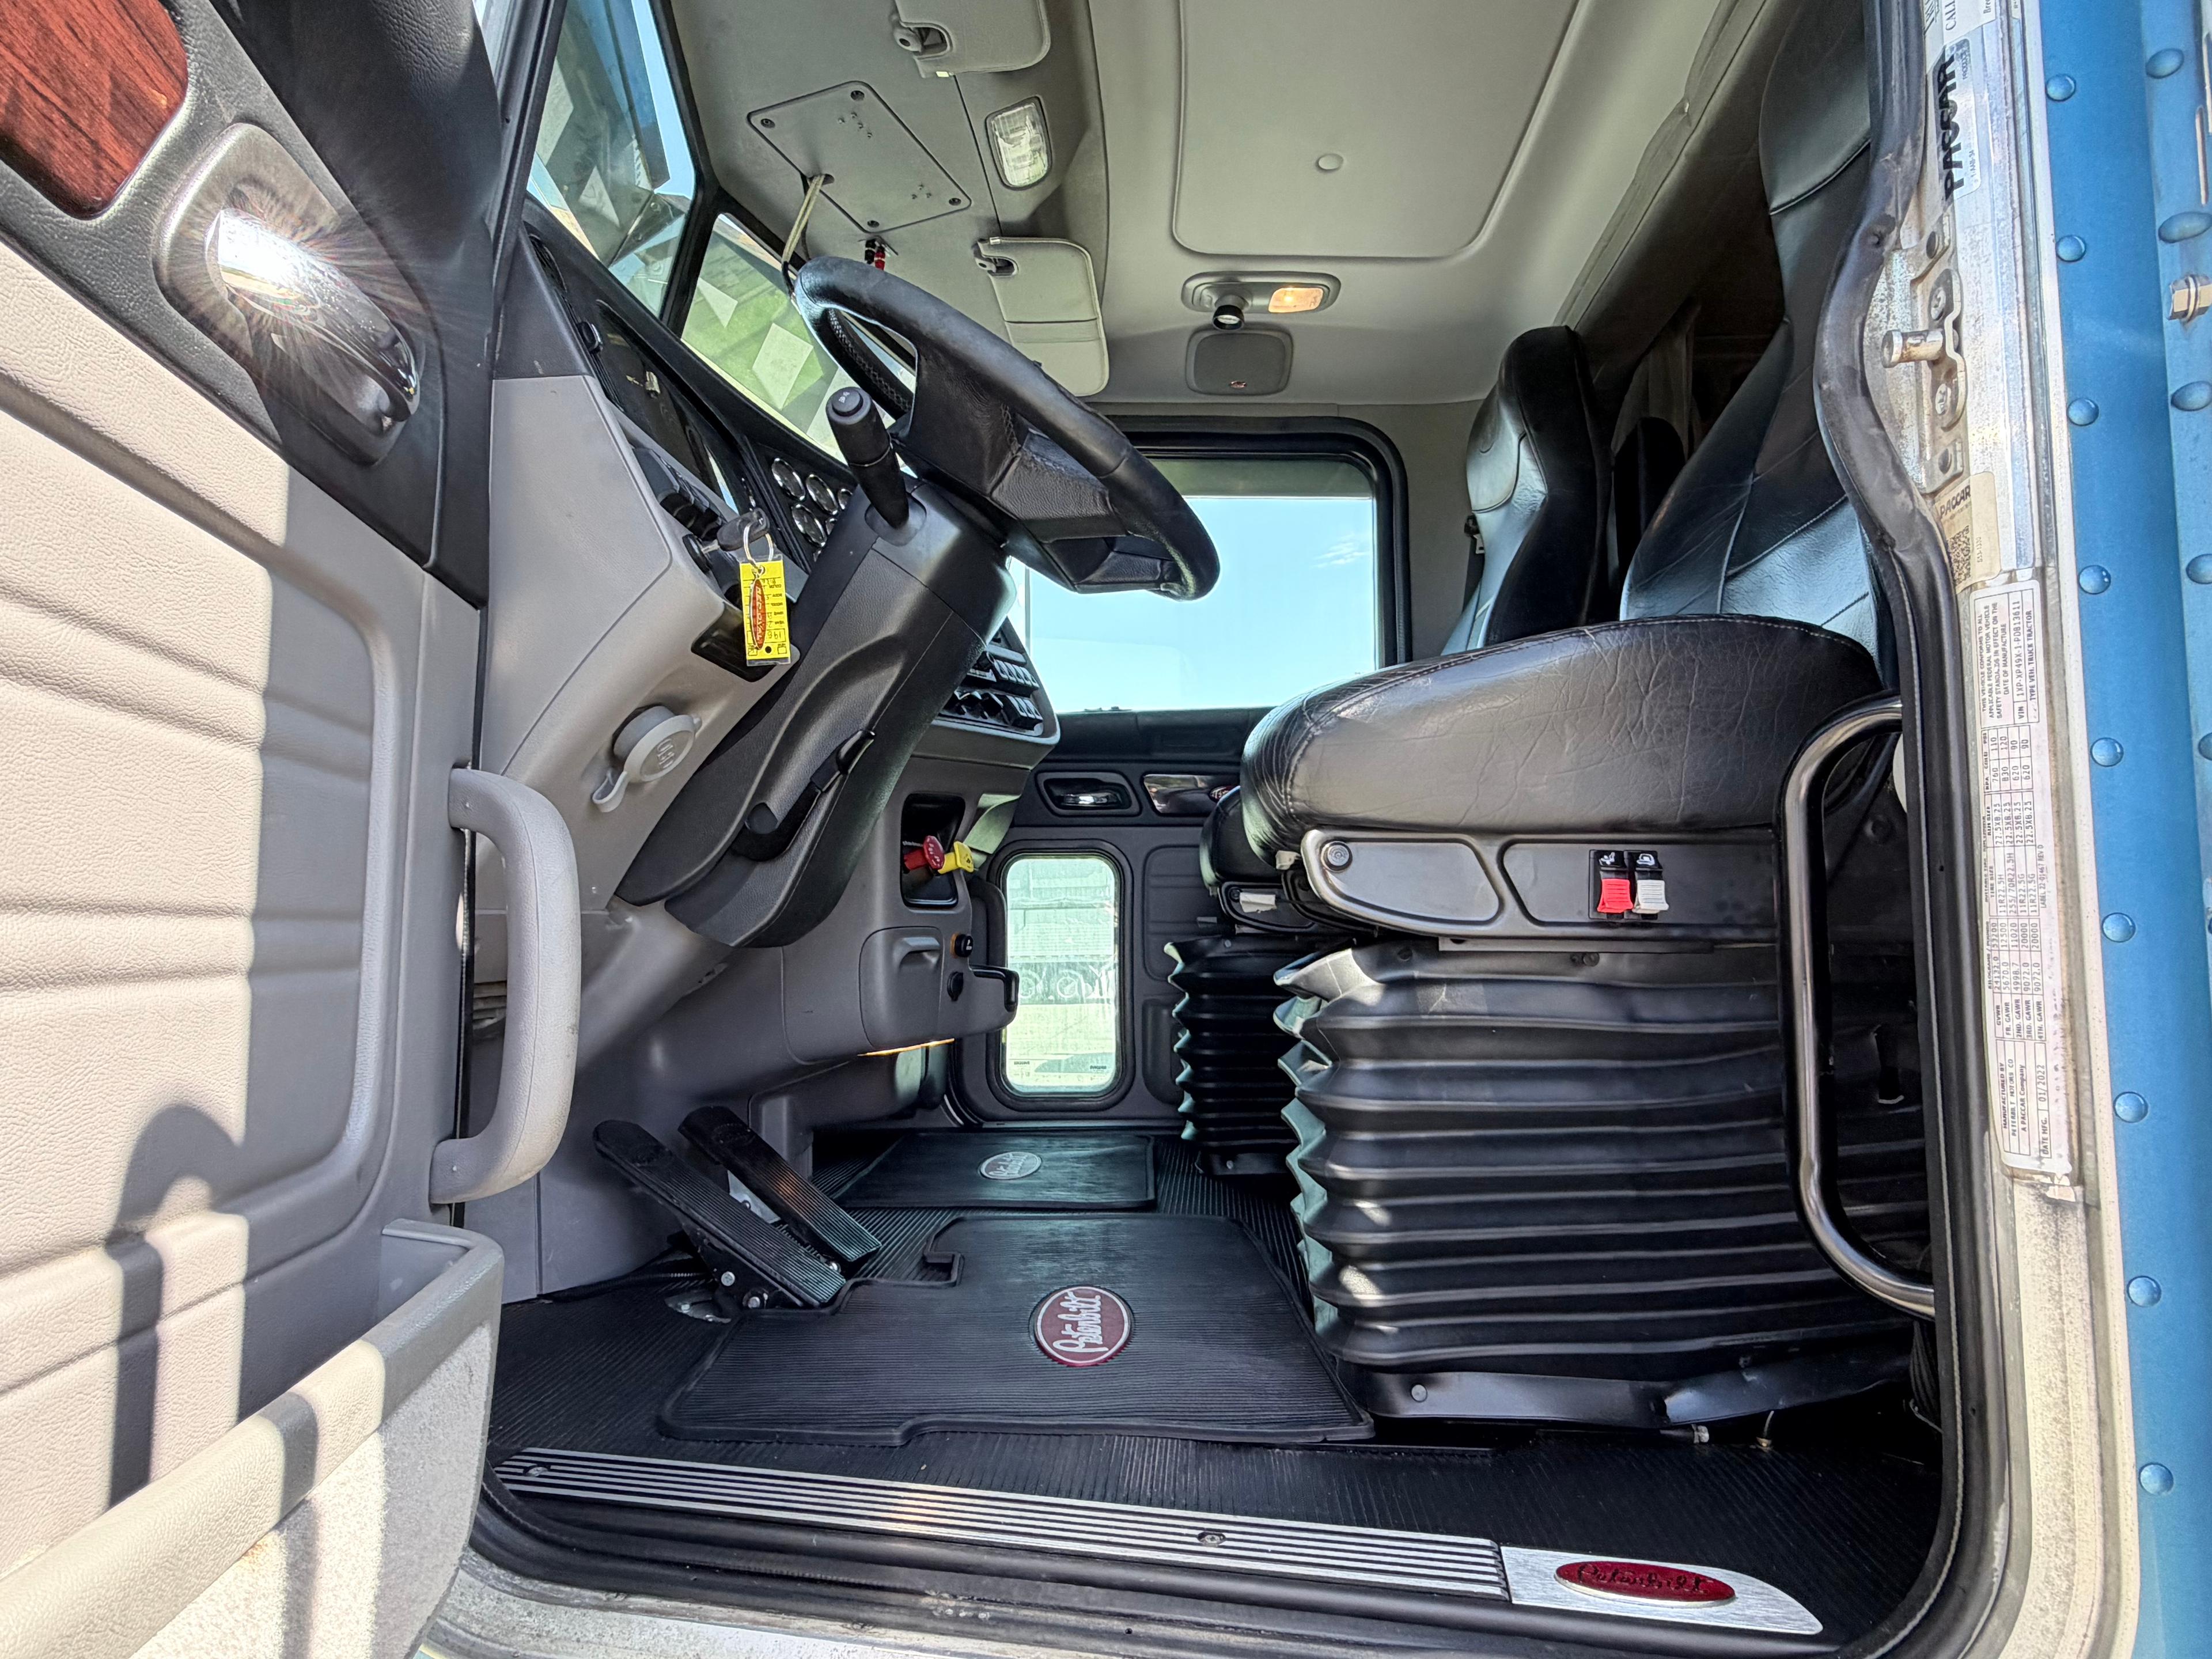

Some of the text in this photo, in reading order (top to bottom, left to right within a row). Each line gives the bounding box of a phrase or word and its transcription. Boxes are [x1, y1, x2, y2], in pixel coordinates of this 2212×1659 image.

[1937, 54, 1964, 199] PACCAR
[1941, 485, 1971, 516] PACCAR
[1978, 626, 1983, 635] TO
[1992, 616, 1998, 624] ON
[2000, 736, 2009, 781] 830 120
[2012, 766, 2020, 781] 620
[2021, 739, 2030, 779] 620 90
[1998, 874, 2006, 913] 11R22.5H
[2006, 853, 2017, 914] 255/70R22.5H
[2018, 873, 2027, 913] 11R22.5G
[2028, 873, 2037, 913] 11R22.5G
[2031, 923, 2039, 949] 20000
[2012, 963, 2020, 991] 4998.7
[2022, 963, 2031, 991] 9072.0
[2033, 963, 2041, 991] 9072.0
[2008, 1059, 2013, 1068] CO
[2036, 1065, 2047, 1101] 01/2022
[1052, 1291, 1109, 1353] Peterbilt
